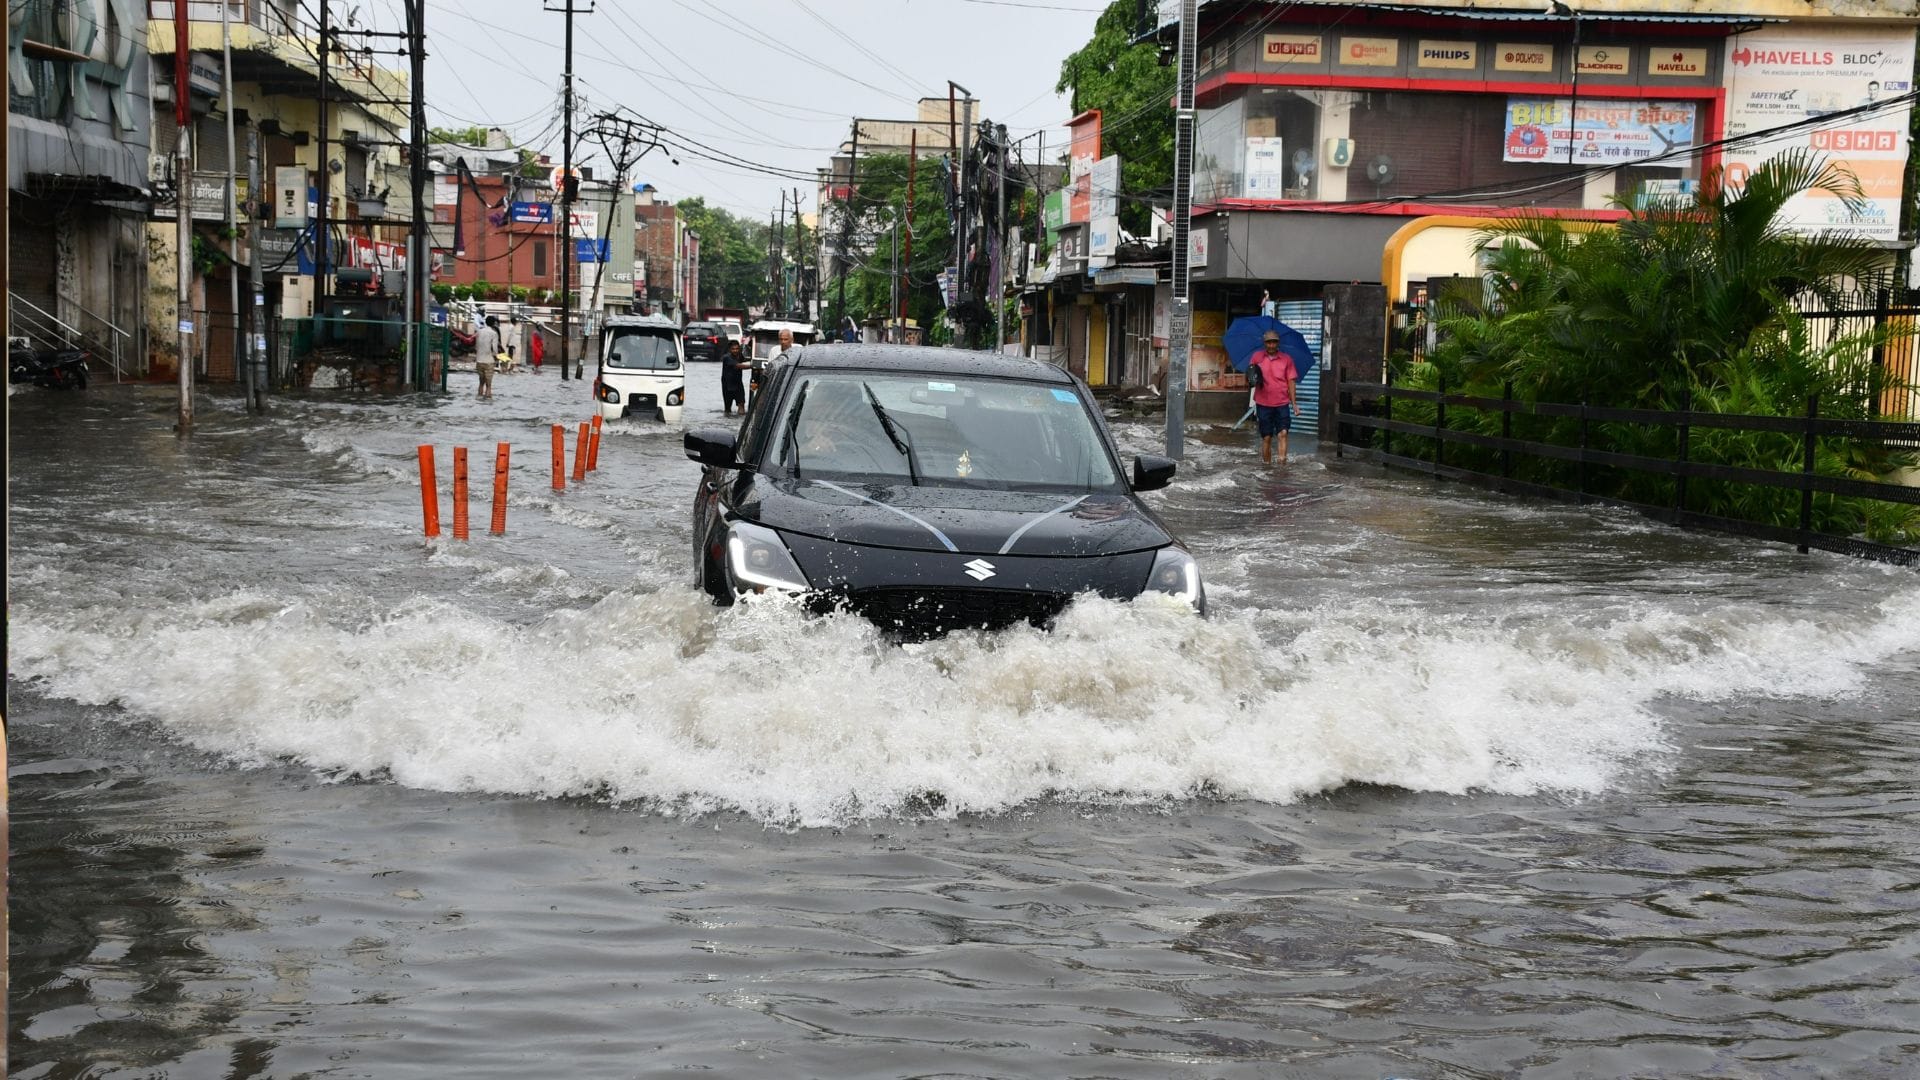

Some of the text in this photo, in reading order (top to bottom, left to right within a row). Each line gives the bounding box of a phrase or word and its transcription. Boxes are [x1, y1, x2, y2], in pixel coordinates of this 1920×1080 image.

[1268, 42, 1317, 55] USHA
[1424, 49, 1470, 60] PHILIPS
[1516, 52, 1544, 64] POLYCAB
[1753, 51, 1833, 65] HAVELLS
[1657, 63, 1696, 72] HAVELLS
[1511, 103, 1563, 126] BIG
[1637, 105, 1691, 126] ऑफर
[1728, 121, 1746, 129] Fans
[1810, 131, 1896, 151] USHA
[1511, 146, 1544, 155] FREE GIFT
